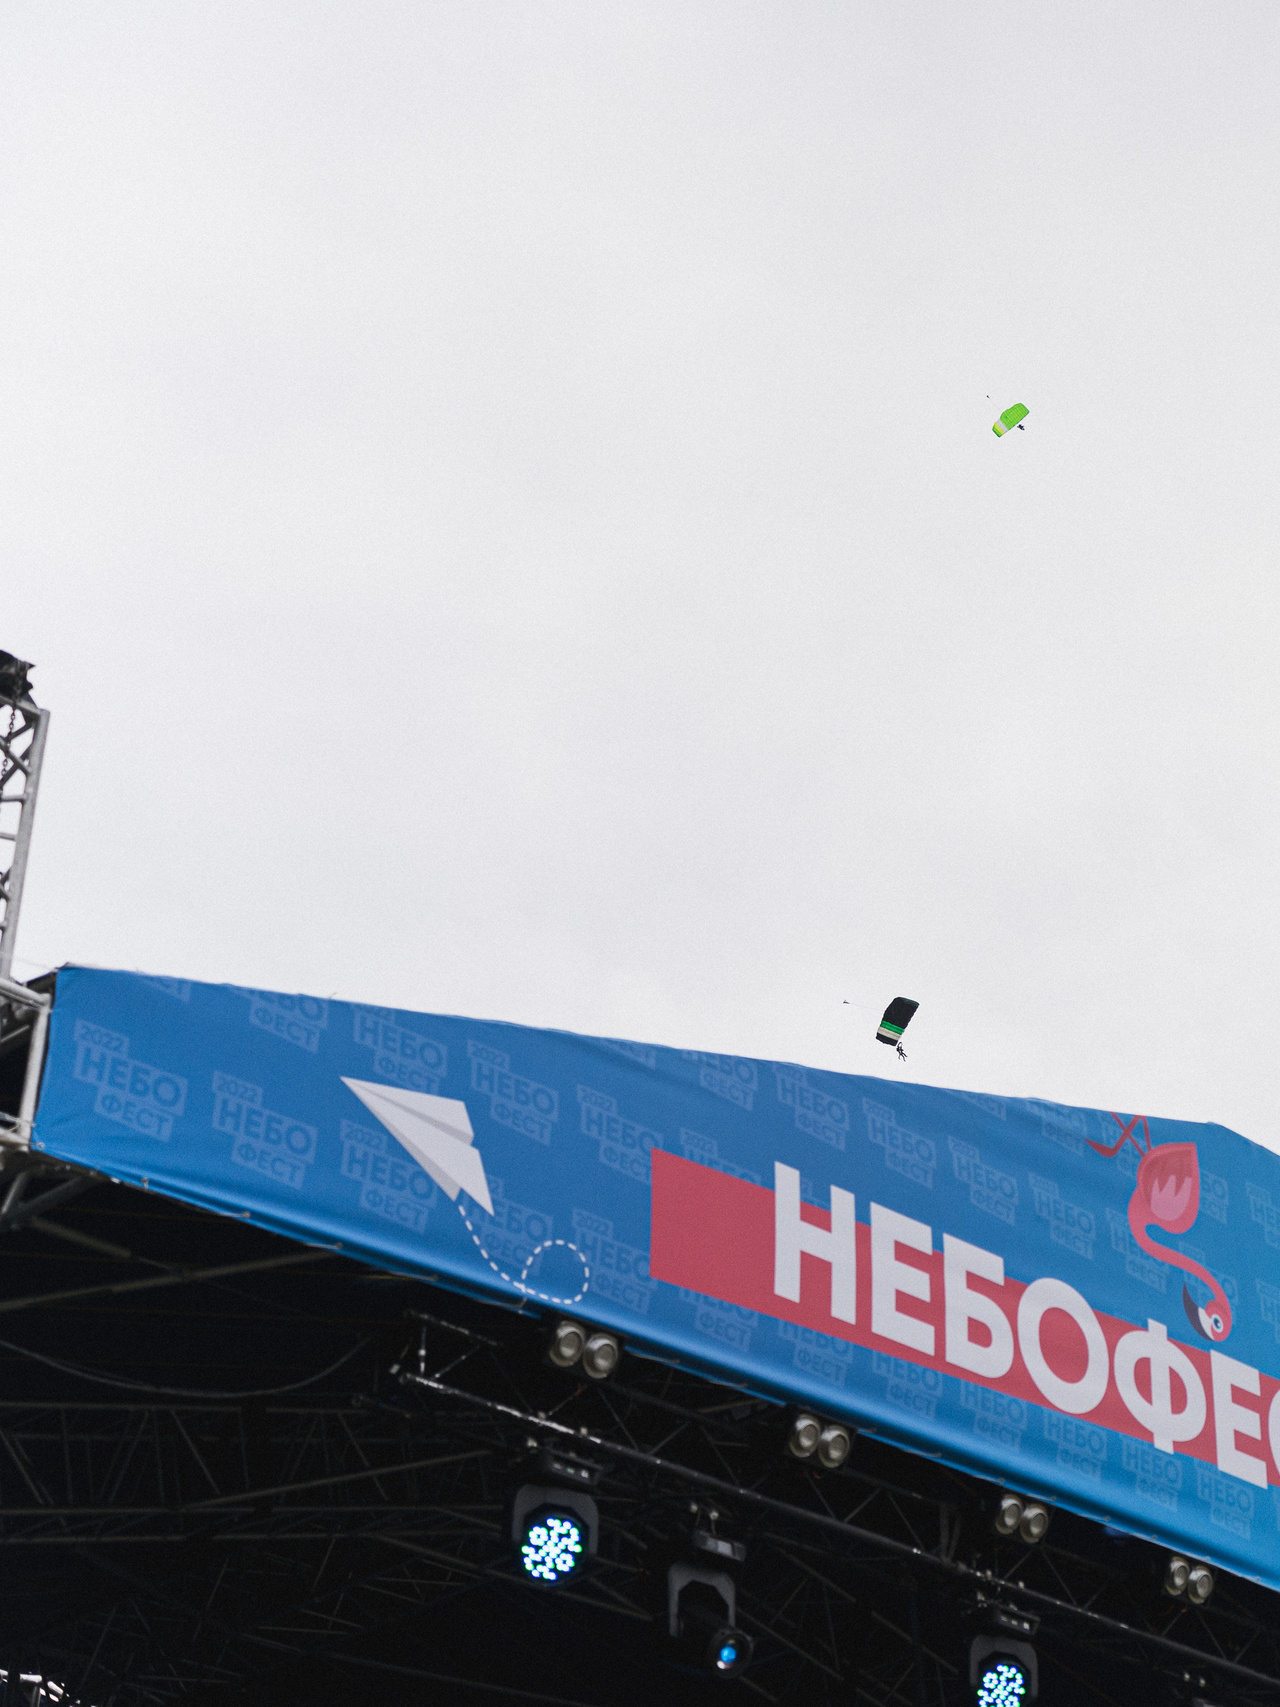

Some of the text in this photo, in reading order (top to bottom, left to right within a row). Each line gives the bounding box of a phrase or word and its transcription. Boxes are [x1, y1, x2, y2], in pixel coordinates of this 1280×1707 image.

[80, 1025, 124, 1051] 2022
[254, 1007, 316, 1046] ФЕСТ
[359, 1015, 443, 1069] НЕБО
[80, 1047, 181, 1108] НЕБО
[217, 1076, 259, 1102] 2022
[378, 1056, 436, 1093] ФЕСТ
[476, 1062, 555, 1115] НЕБО
[703, 1073, 749, 1107] ФЕСТ
[101, 1093, 169, 1136] ФЕСТ
[494, 1103, 548, 1139] ФЕСТ
[781, 1079, 846, 1124] НЕБО
[218, 1098, 312, 1155] НЕБО
[798, 1113, 842, 1146] ФЕСТ
[871, 1117, 933, 1162] НЕБО
[237, 1143, 301, 1182] ФЕСТ
[347, 1145, 434, 1200] НЕБО
[888, 1152, 929, 1183] ФЕСТ
[957, 1155, 1015, 1199] НЕБО
[365, 1188, 424, 1226] ФЕСТ
[1038, 1191, 1093, 1235] НЕБО
[580, 1232, 651, 1283] НЕБО
[595, 1273, 647, 1310] ФЕСТ
[699, 1312, 748, 1347] ФЕСТ
[797, 1347, 843, 1381] ФЕСТ
[965, 1383, 1024, 1423] НЕБО
[1048, 1413, 1105, 1455] НЕБО
[1126, 1443, 1179, 1486] НЕБО
[1200, 1472, 1251, 1513] НЕБО
